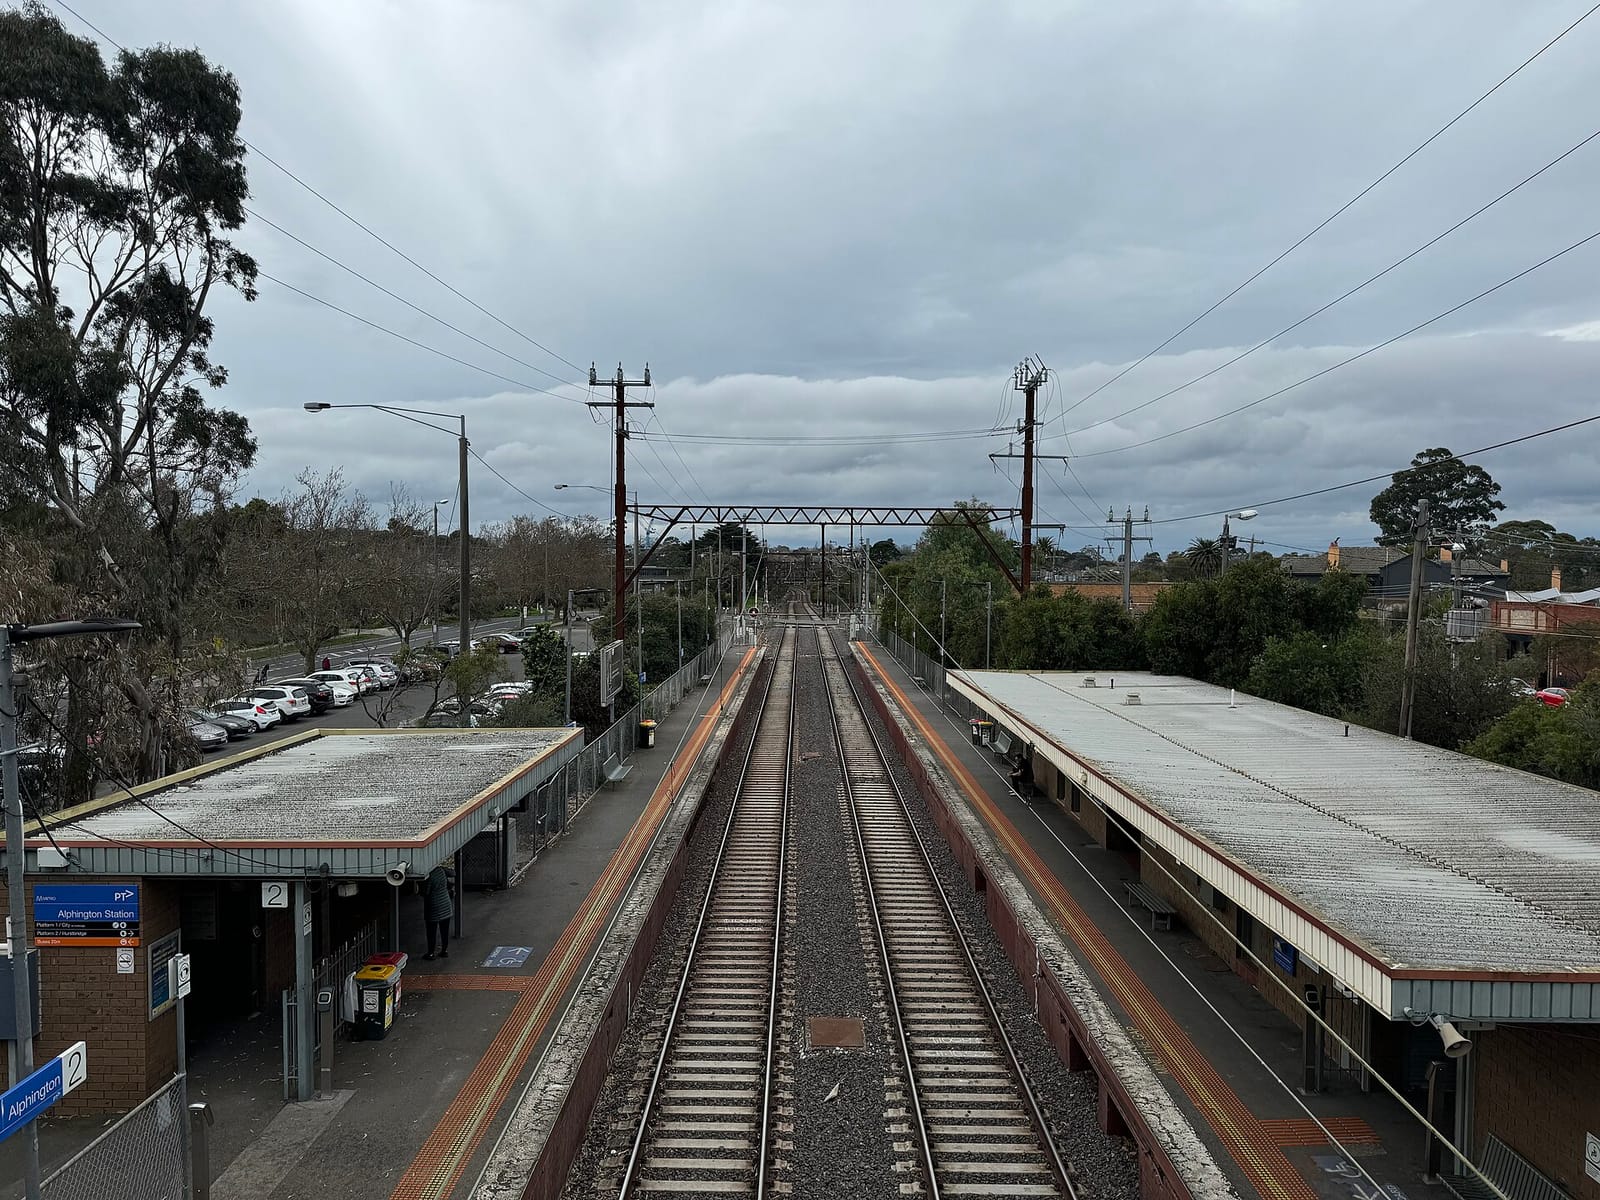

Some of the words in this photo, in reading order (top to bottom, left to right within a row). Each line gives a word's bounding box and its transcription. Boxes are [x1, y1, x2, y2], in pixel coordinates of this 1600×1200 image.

[268, 885, 282, 905] 2
[58, 909, 102, 920] Alphington
[104, 909, 134, 919] Station
[69, 1052, 82, 1087] 2
[8, 1076, 61, 1120] Alphington
